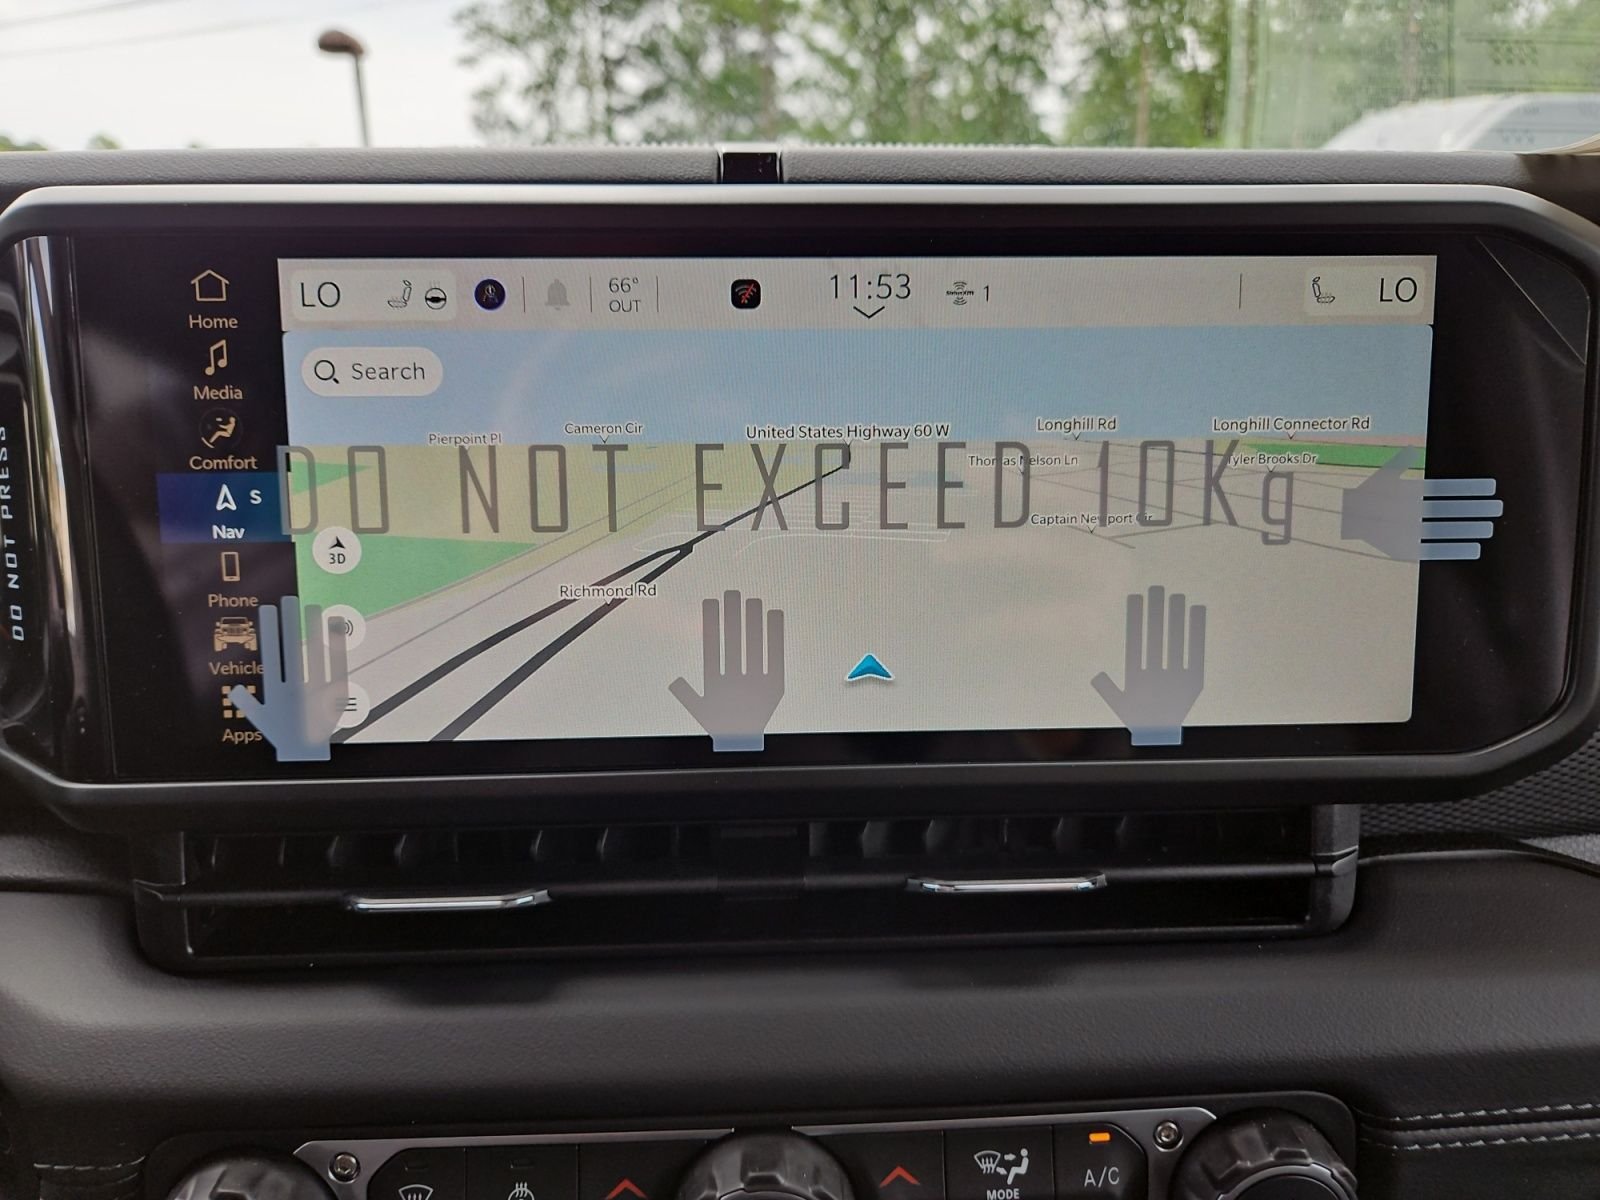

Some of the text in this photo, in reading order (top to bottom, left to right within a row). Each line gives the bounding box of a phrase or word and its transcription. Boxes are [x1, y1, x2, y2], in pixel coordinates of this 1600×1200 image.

[300, 281, 341, 308] LO
[830, 273, 911, 301] 11:53
[983, 284, 990, 303] 1
[1379, 277, 1418, 303] LO
[608, 300, 641, 313] OUT
[188, 314, 239, 329] Home
[351, 361, 426, 381] Search
[193, 384, 244, 400] Media
[564, 422, 643, 434] Cameron Cir
[745, 423, 950, 441] United States Highway 60 W
[1036, 417, 1117, 433] Longhill Rd
[1213, 416, 1371, 434] Longhill Connector Rd
[428, 433, 488, 446] Pierpoint
[189, 456, 258, 470] Comfort
[1064, 454, 1078, 466] Ln
[1258, 453, 1300, 465] Brooks
[1302, 453, 1317, 464] Dr
[276, 440, 1295, 545] DO NOT EXCEED 10Kg
[1030, 510, 1153, 526] Captain Neport ir
[211, 525, 246, 540] Nav
[4, 535, 20, 590] NOT
[329, 552, 346, 565] 3D
[560, 583, 657, 598] Richmond Rd
[208, 593, 259, 608] Phone
[10, 604, 25, 642] DO
[209, 661, 265, 675] Vehicle
[222, 728, 263, 744] Apps
[1084, 1166, 1120, 1188] A/C
[986, 1188, 1020, 1200] MODE
